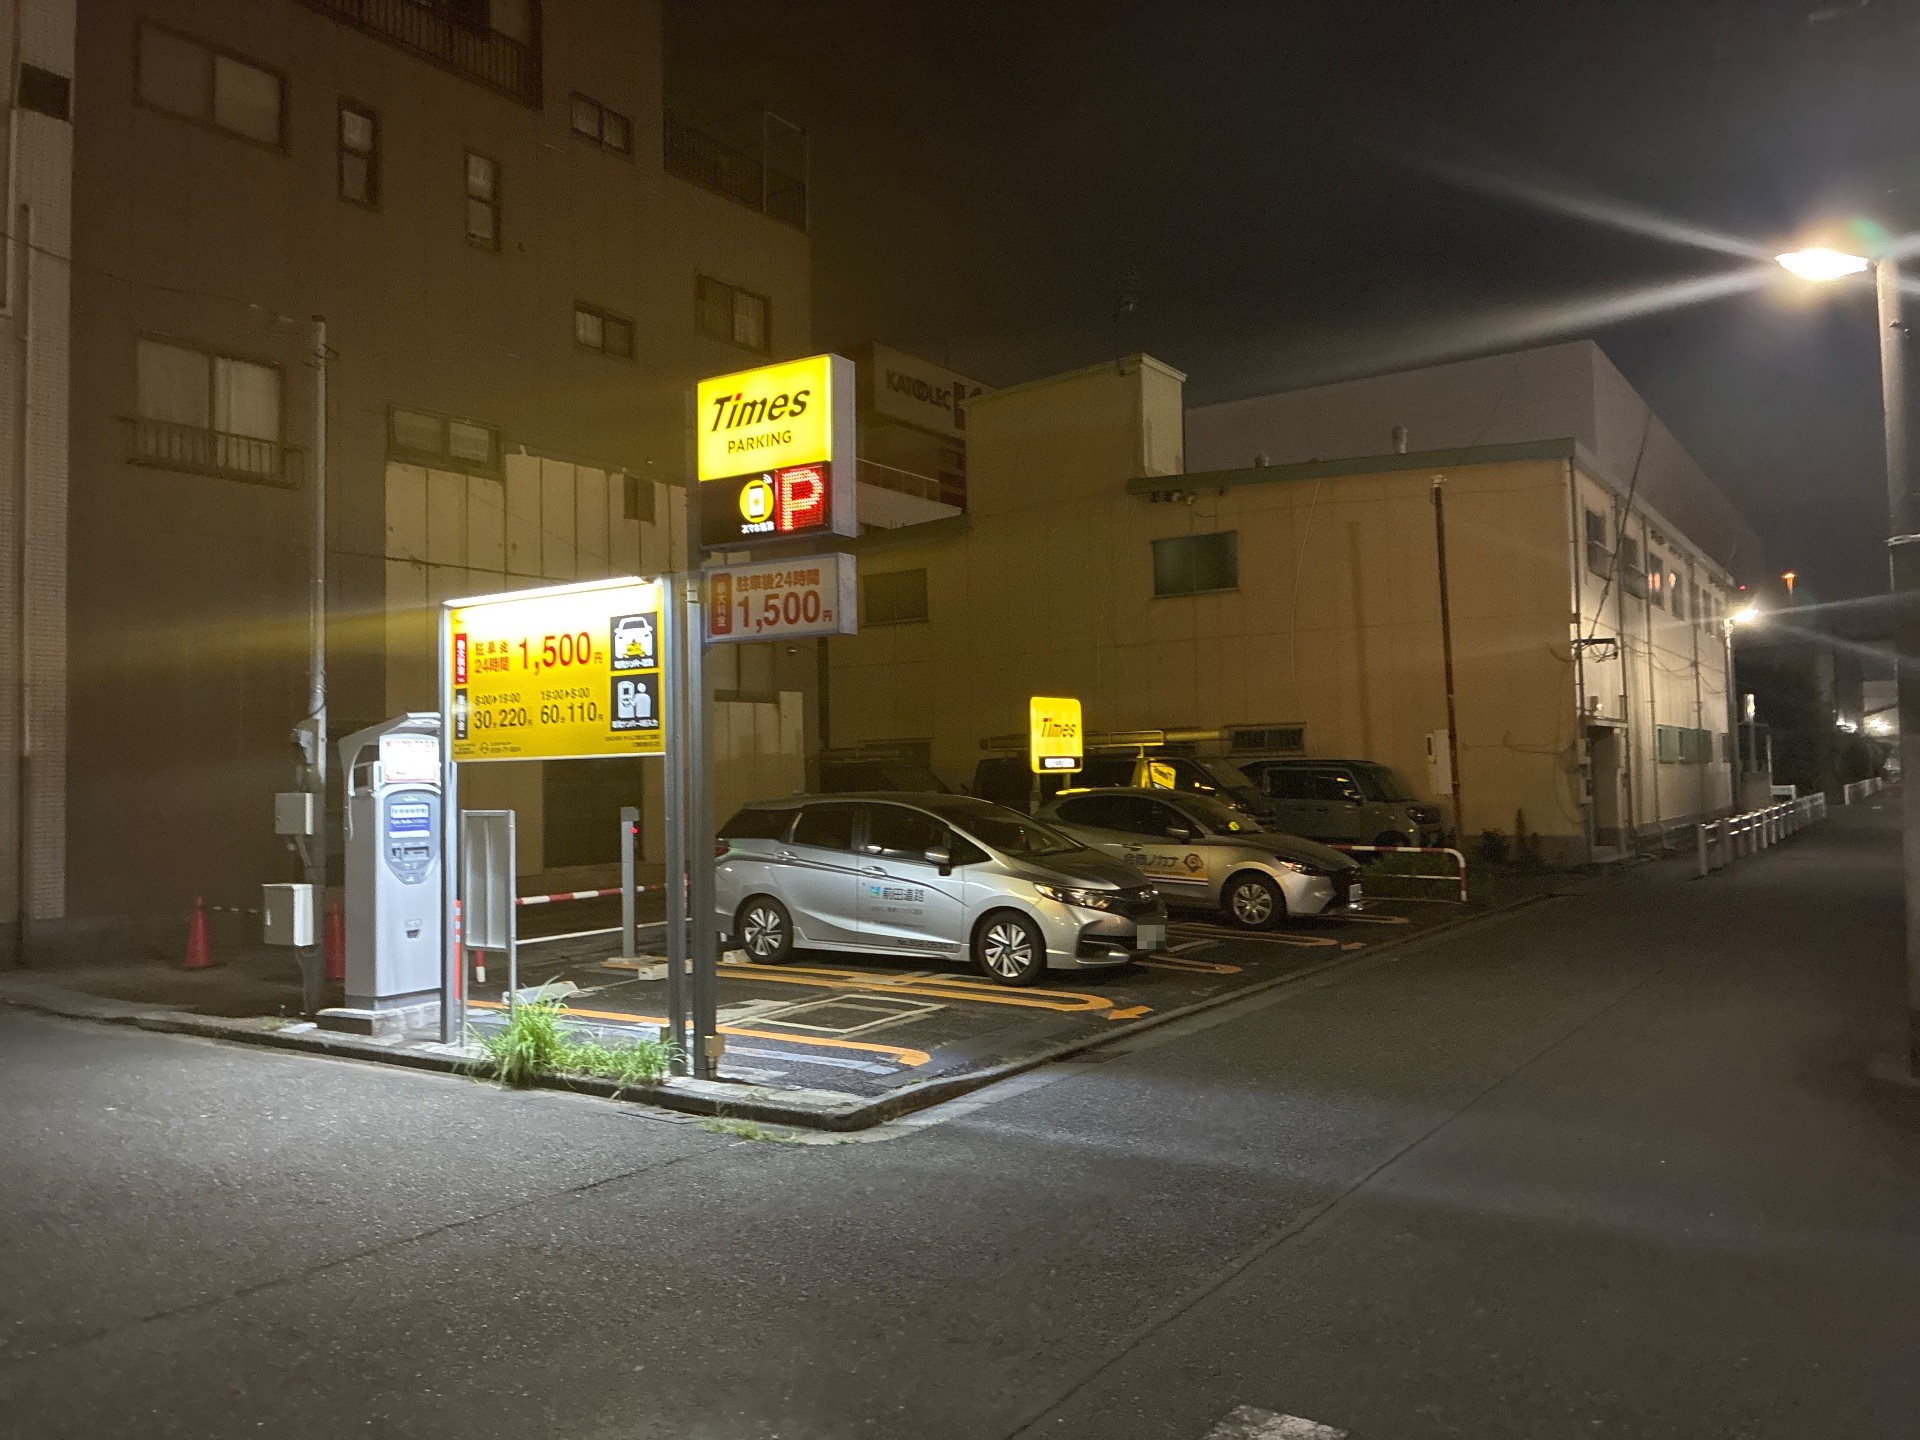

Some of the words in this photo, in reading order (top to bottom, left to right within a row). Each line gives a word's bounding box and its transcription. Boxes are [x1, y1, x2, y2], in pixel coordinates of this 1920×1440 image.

[712, 390, 810, 432] Times
[728, 429, 792, 454] PARKING
[782, 469, 823, 531] P
[736, 568, 820, 592] 駐車後24時間
[1041, 717, 1076, 738] Times
